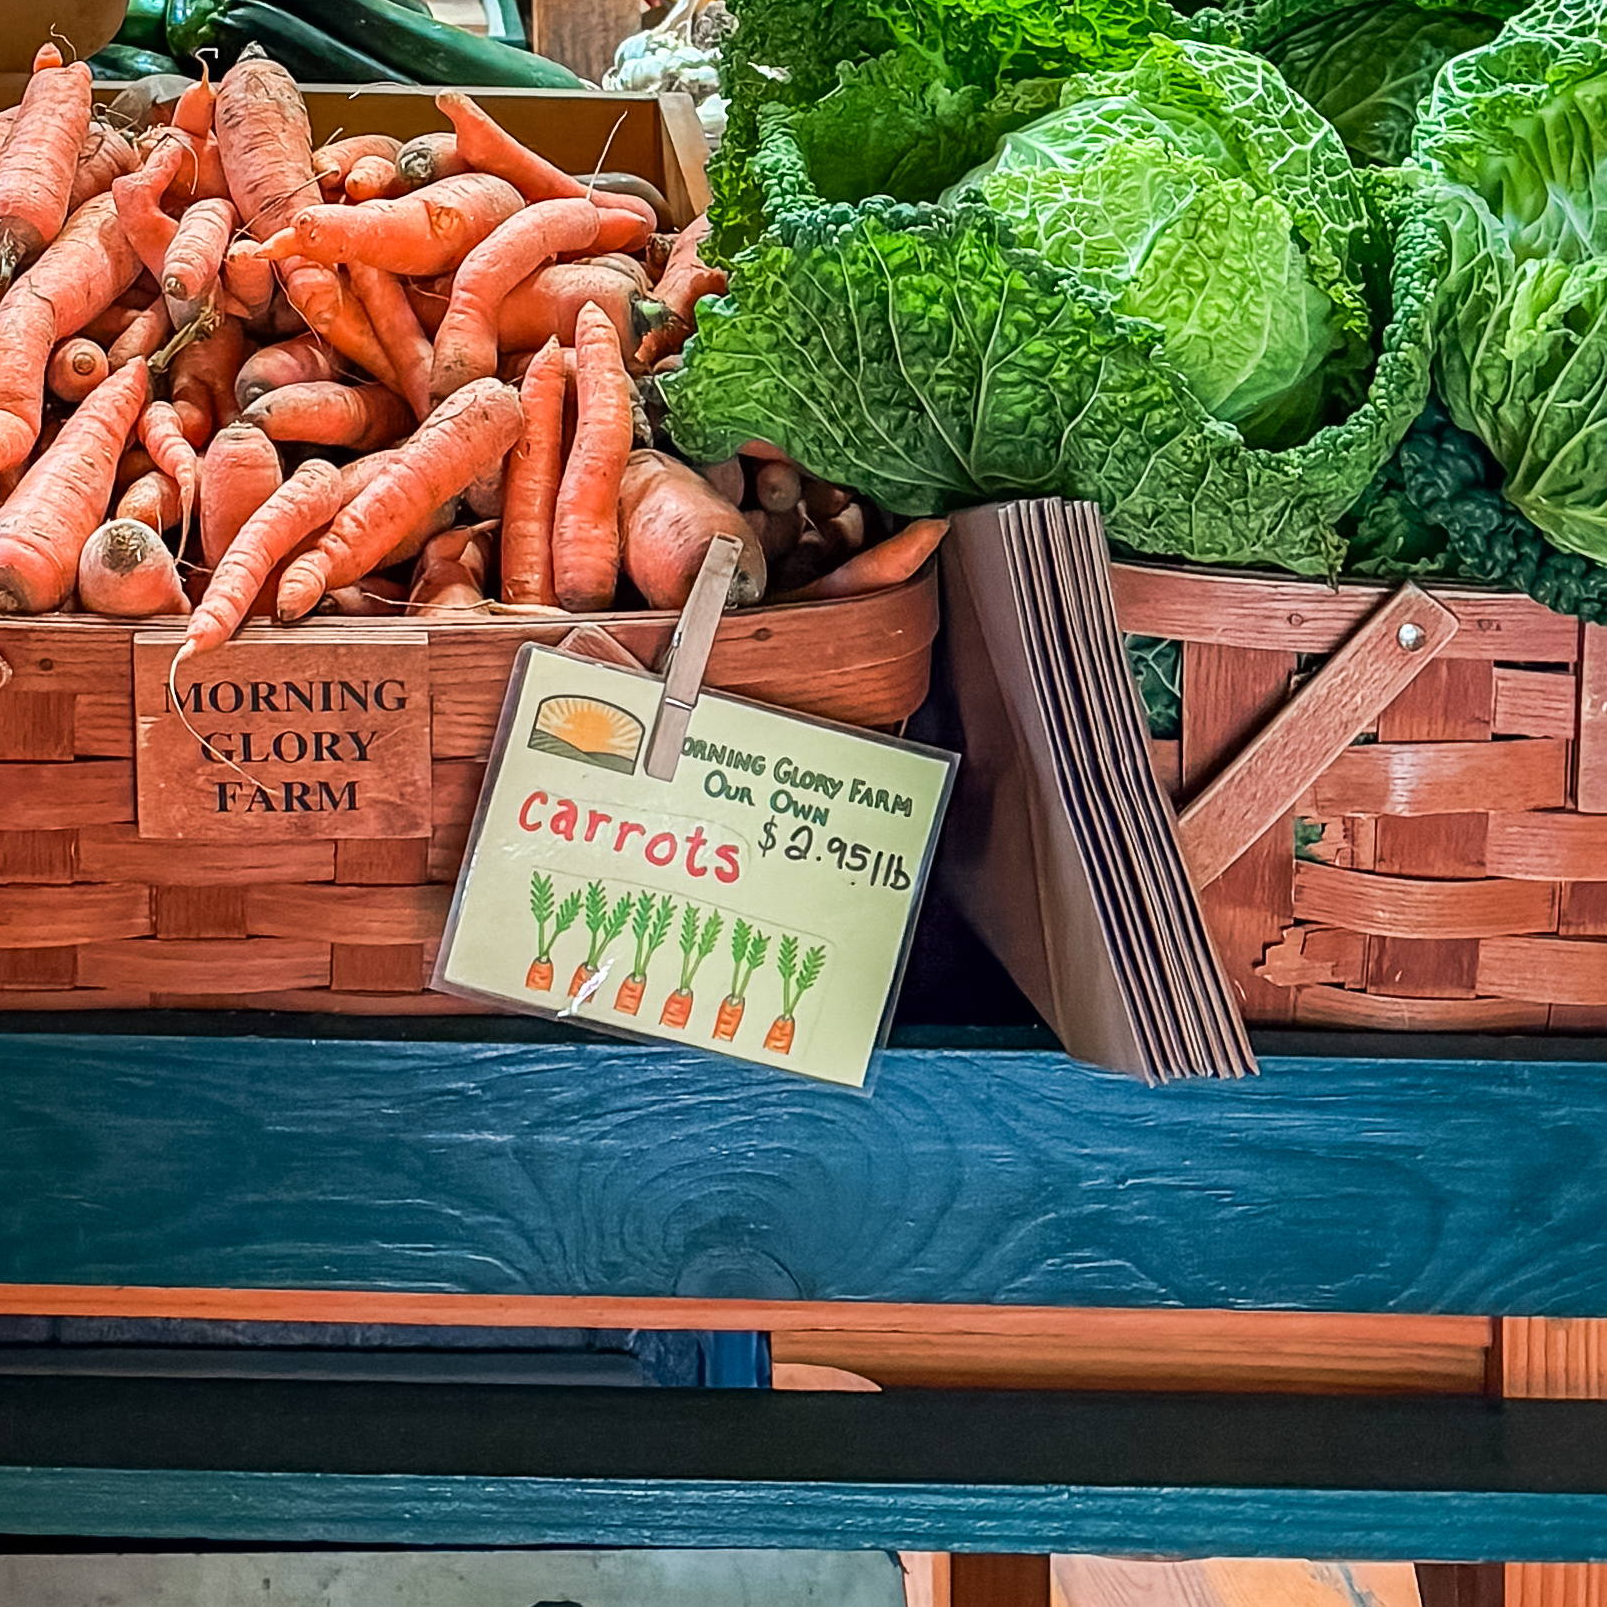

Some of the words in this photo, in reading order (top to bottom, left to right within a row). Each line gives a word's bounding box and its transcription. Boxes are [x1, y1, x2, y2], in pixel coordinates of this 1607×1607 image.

[162, 679, 408, 713] MORNING
[200, 730, 378, 764] GLORY
[215, 780, 360, 813] FARM
[681, 737, 766, 776] ORNING
[773, 757, 844, 799] GLORY
[848, 778, 913, 818] FARM
[703, 769, 755, 806] OUR
[769, 788, 830, 827] OWN
[518, 791, 741, 884] carrots
